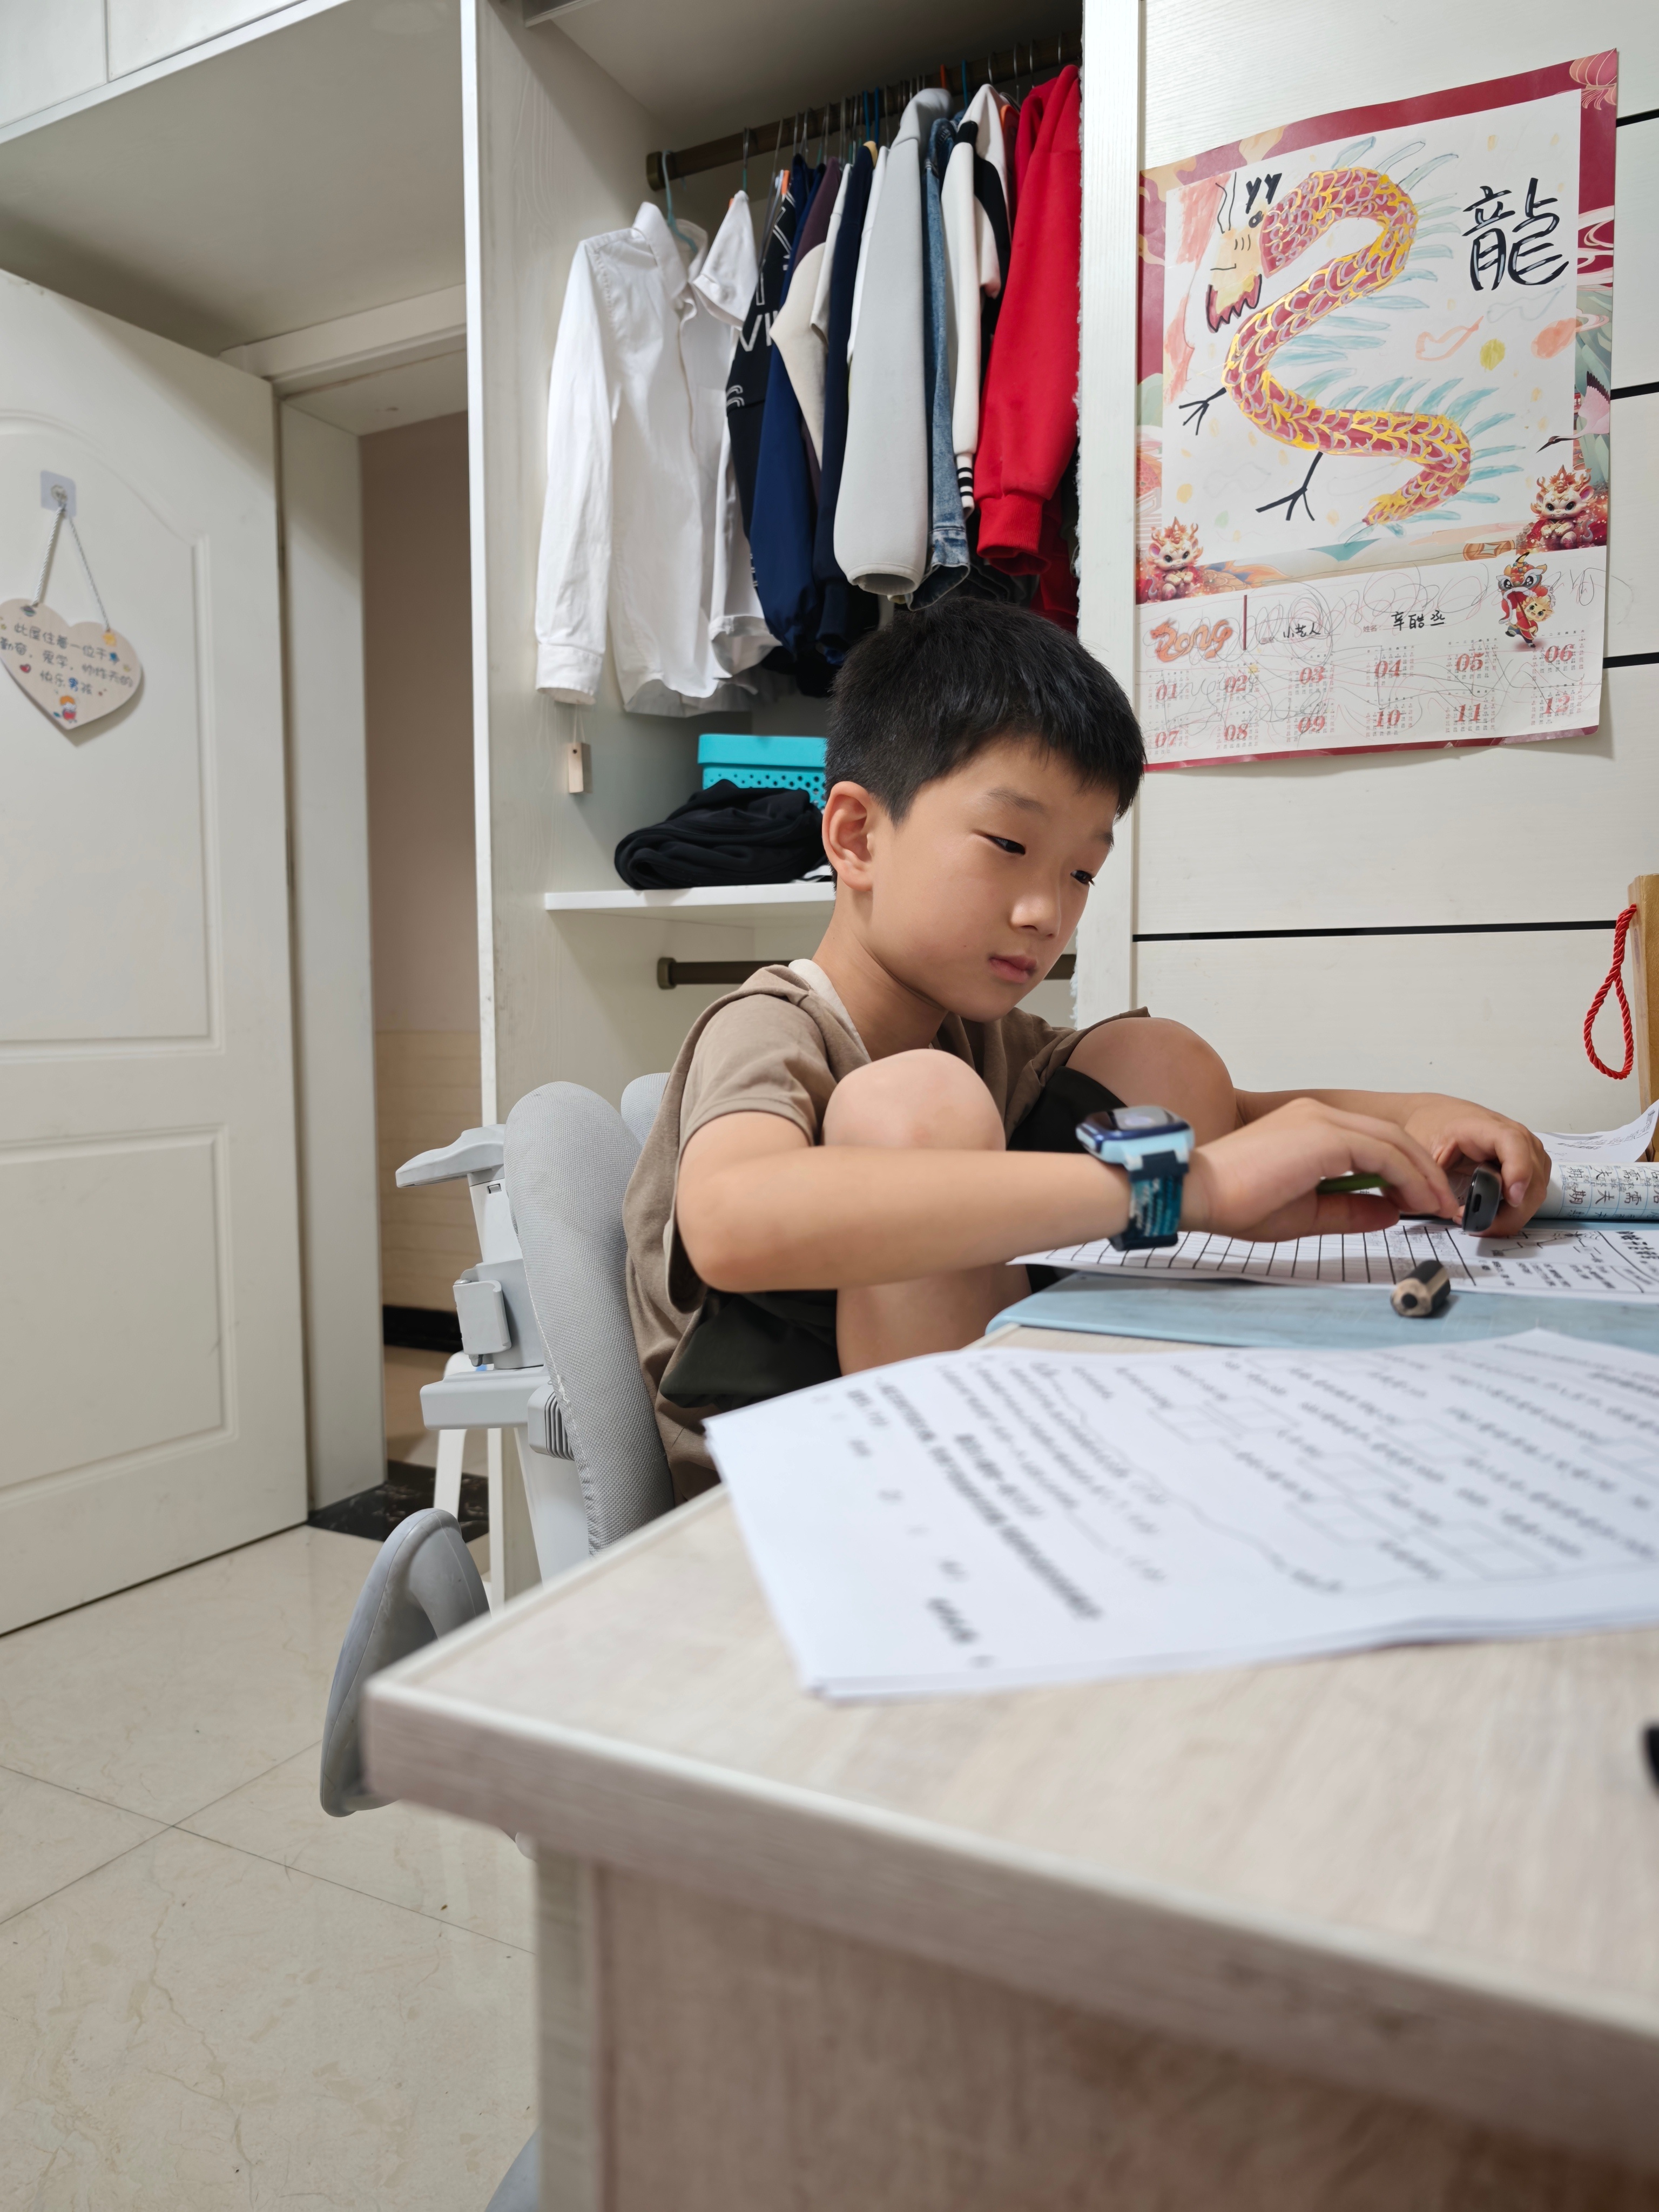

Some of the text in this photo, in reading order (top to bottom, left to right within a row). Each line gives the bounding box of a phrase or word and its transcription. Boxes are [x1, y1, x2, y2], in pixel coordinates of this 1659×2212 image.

[1462, 177, 1569, 291] 龍
[1456, 652, 1484, 673] 05
[1545, 644, 1573, 664] 06
[1299, 666, 1325, 685] 03
[1374, 658, 1402, 678] 04
[1156, 683, 1177, 701] 01
[1225, 675, 1249, 694] 02
[1456, 703, 1481, 723] 11
[1543, 694, 1569, 714] 12
[1297, 716, 1326, 734] 09
[1375, 709, 1401, 727] 10
[1155, 731, 1179, 748] 07
[1224, 723, 1249, 742] 08
